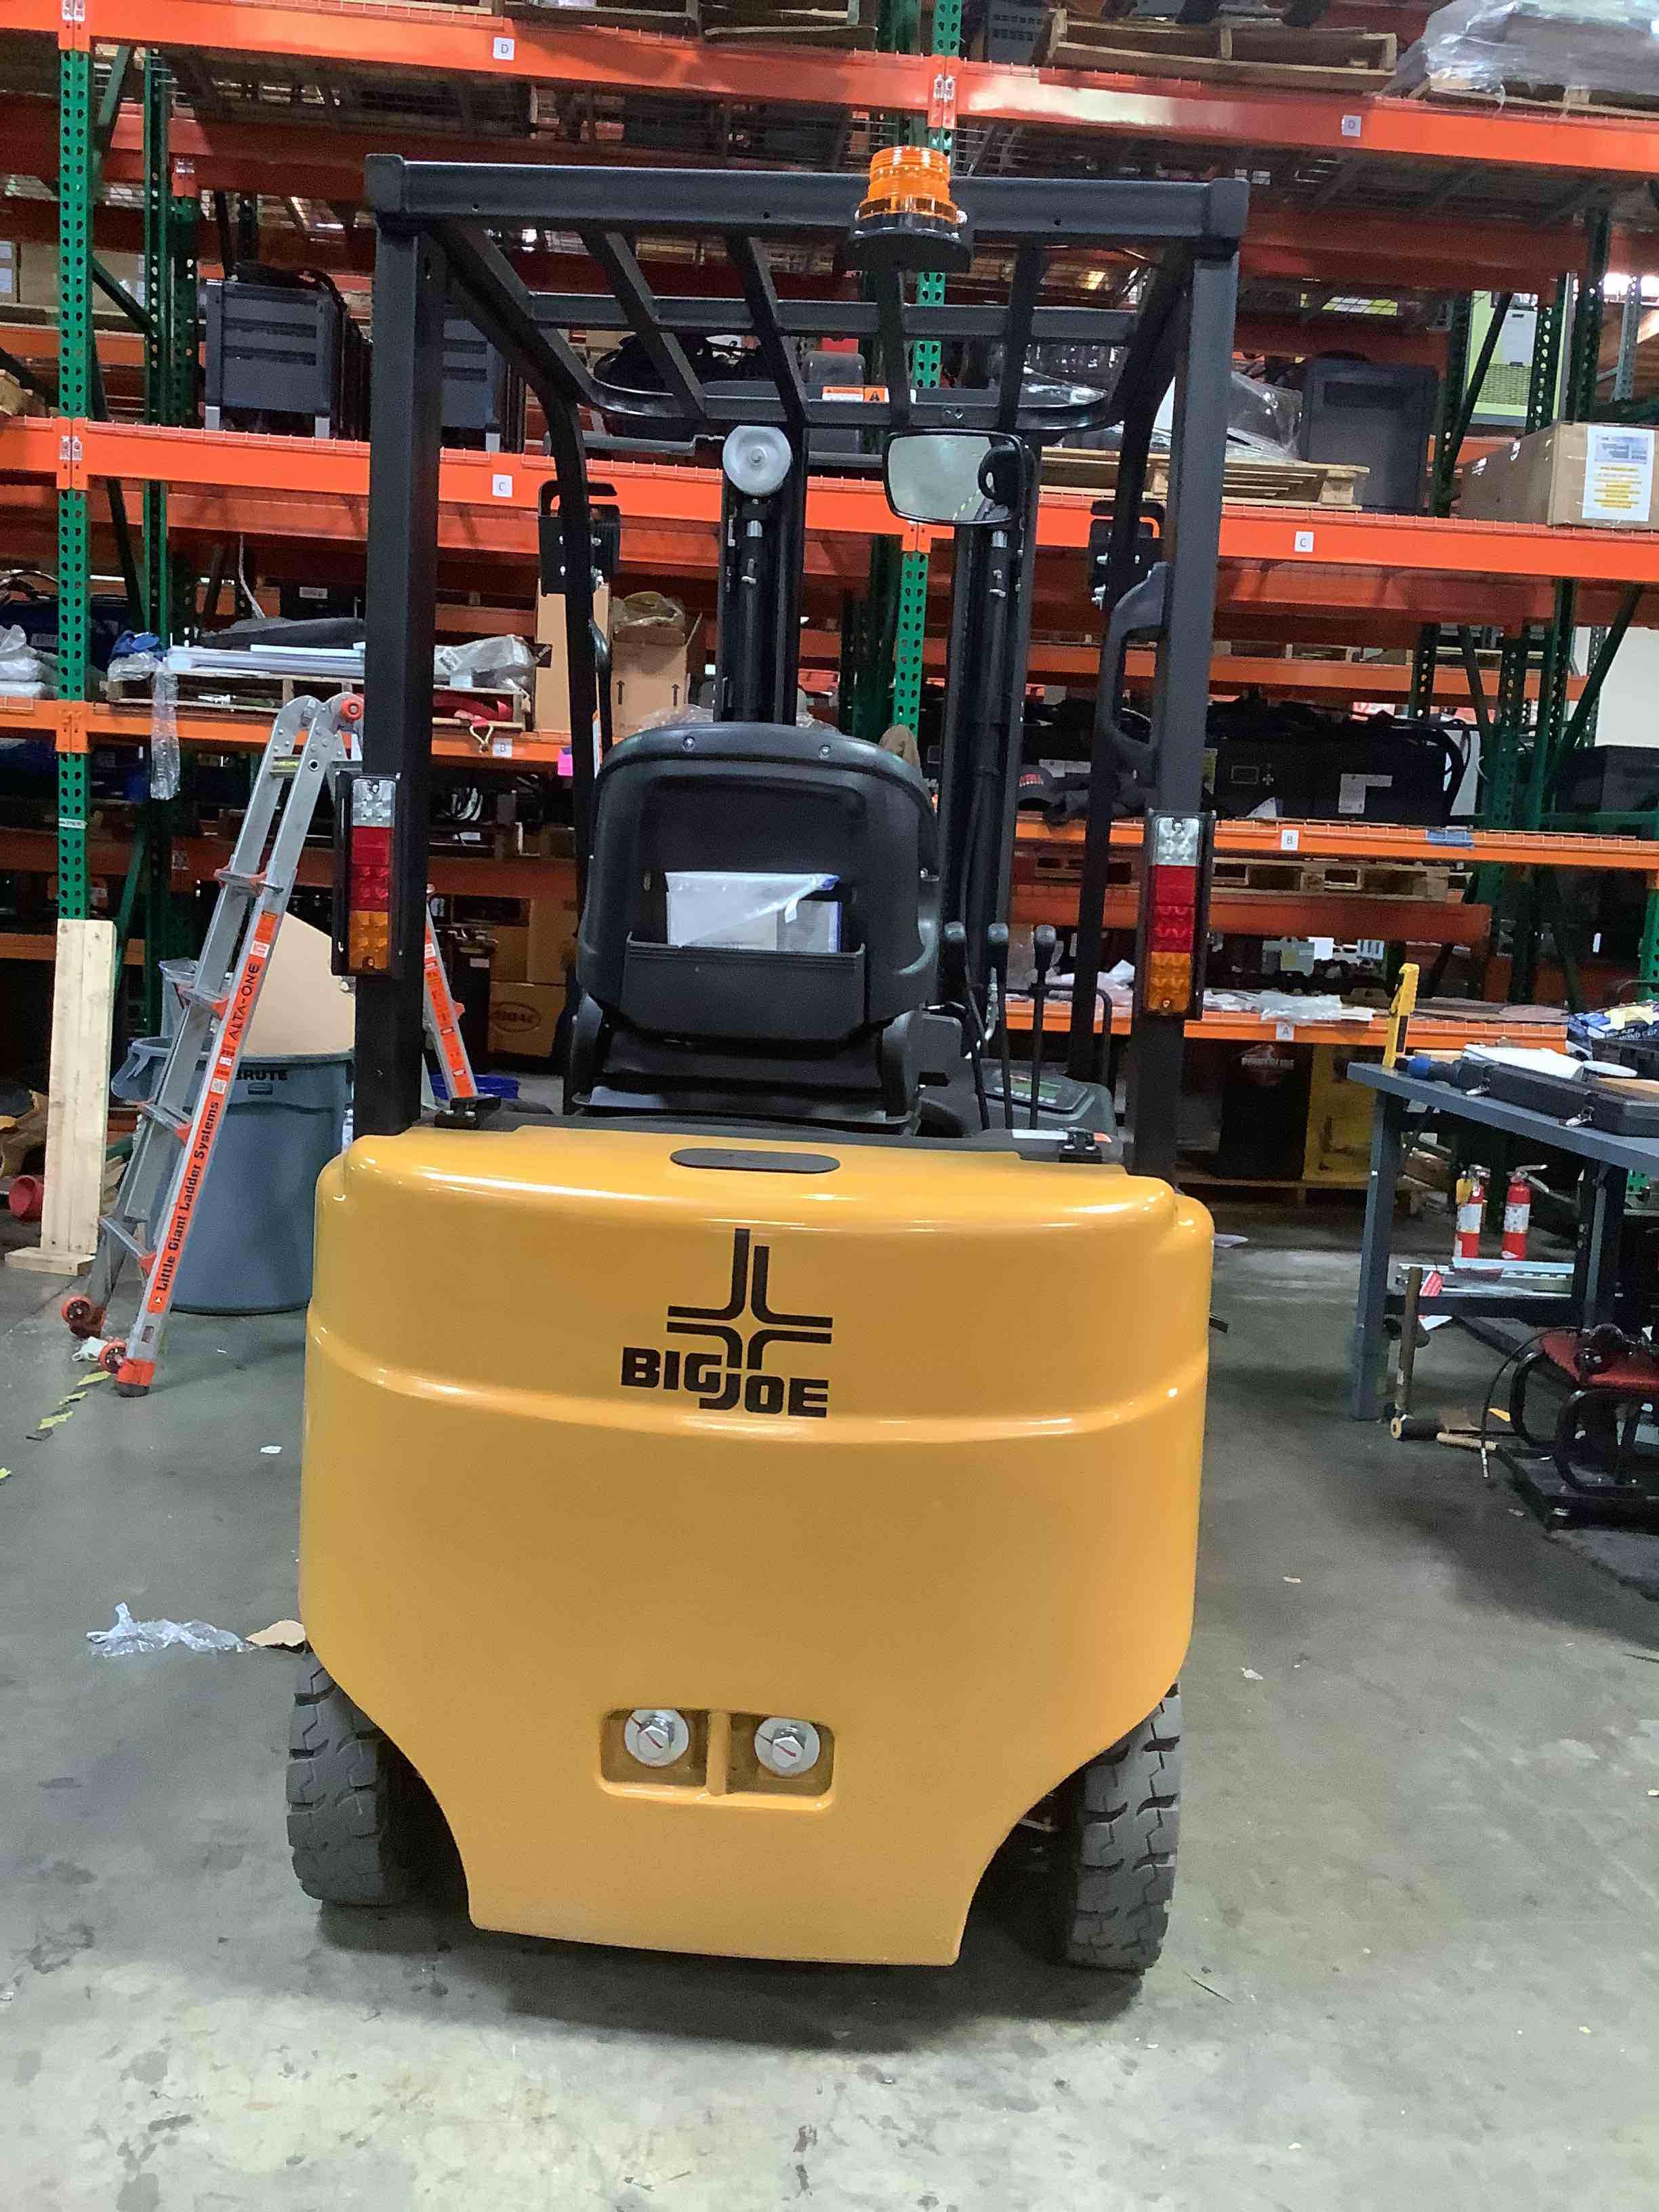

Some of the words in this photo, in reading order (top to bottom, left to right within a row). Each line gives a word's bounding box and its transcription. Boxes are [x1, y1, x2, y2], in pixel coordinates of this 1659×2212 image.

[501, 43, 509, 54] D
[1348, 119, 1356, 129] D
[499, 482, 506, 491] C
[1300, 537, 1307, 547] C
[1287, 835, 1294, 844] B
[229, 962, 261, 1042] ALTA-ONE
[1282, 1027, 1290, 1036] A
[156, 1256, 175, 1292] Little
[169, 1214, 186, 1251] Giant
[180, 1163, 202, 1212] Ladder
[194, 1101, 219, 1160] Systems
